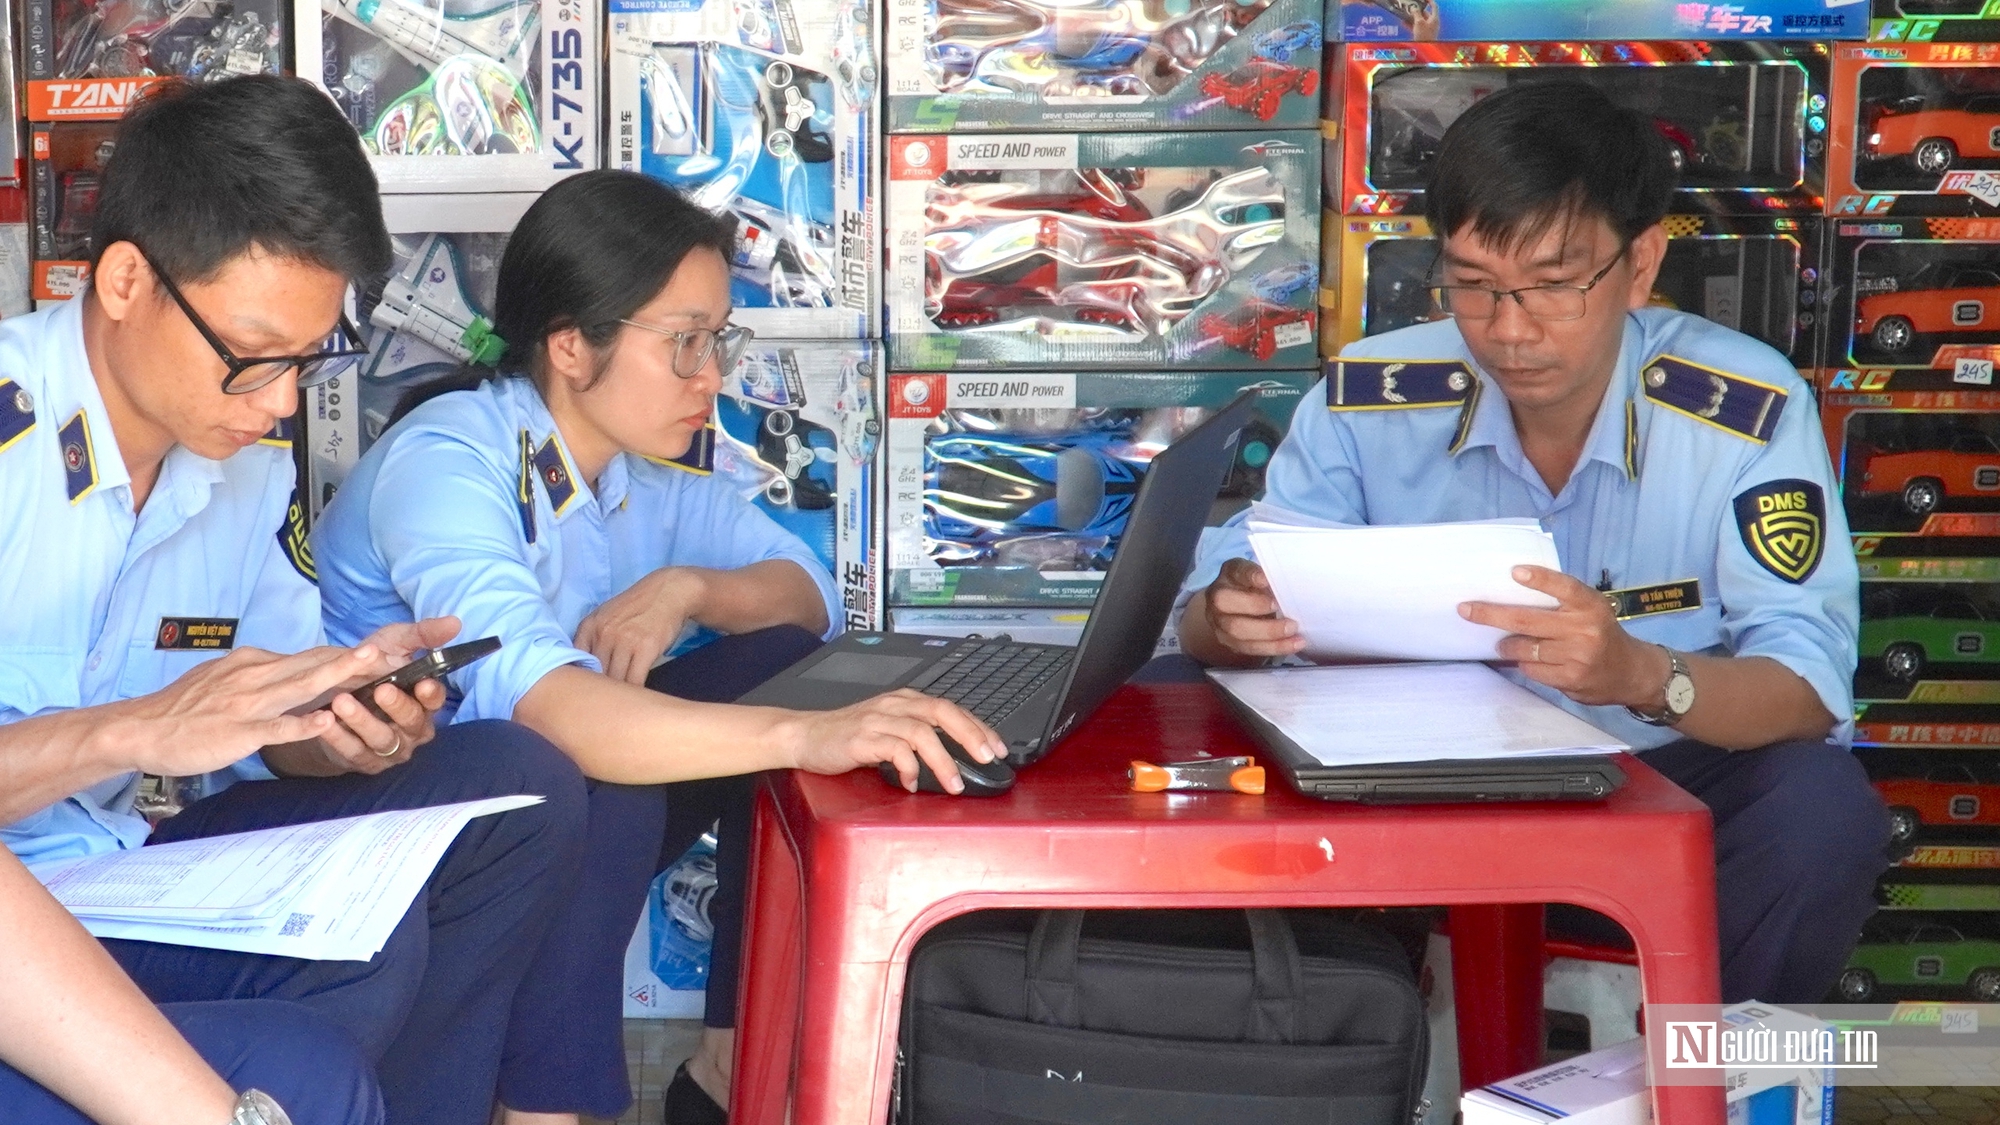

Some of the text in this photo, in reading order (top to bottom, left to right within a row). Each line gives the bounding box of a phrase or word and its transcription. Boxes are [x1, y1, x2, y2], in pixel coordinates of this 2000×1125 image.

[898, 16, 917, 25] RC
[1361, 16, 1383, 25] APP
[1877, 20, 1940, 41] RC
[551, 28, 584, 169] K-735
[1042, 112, 1062, 120] DRIVE
[1064, 112, 1097, 120] STRAIGHT
[1099, 112, 1114, 120] AND
[957, 142, 1067, 159] SPEED AND POWER
[1829, 195, 1896, 216] RC
[865, 196, 874, 240] POLICE
[899, 255, 918, 264] RC
[1828, 369, 1892, 390] RC
[1956, 362, 1989, 380] 245
[956, 381, 1064, 398] SPEED AND POWER
[898, 492, 917, 500] RC
[1758, 491, 1808, 513] DMS
[868, 548, 877, 623] CITY POLICE
